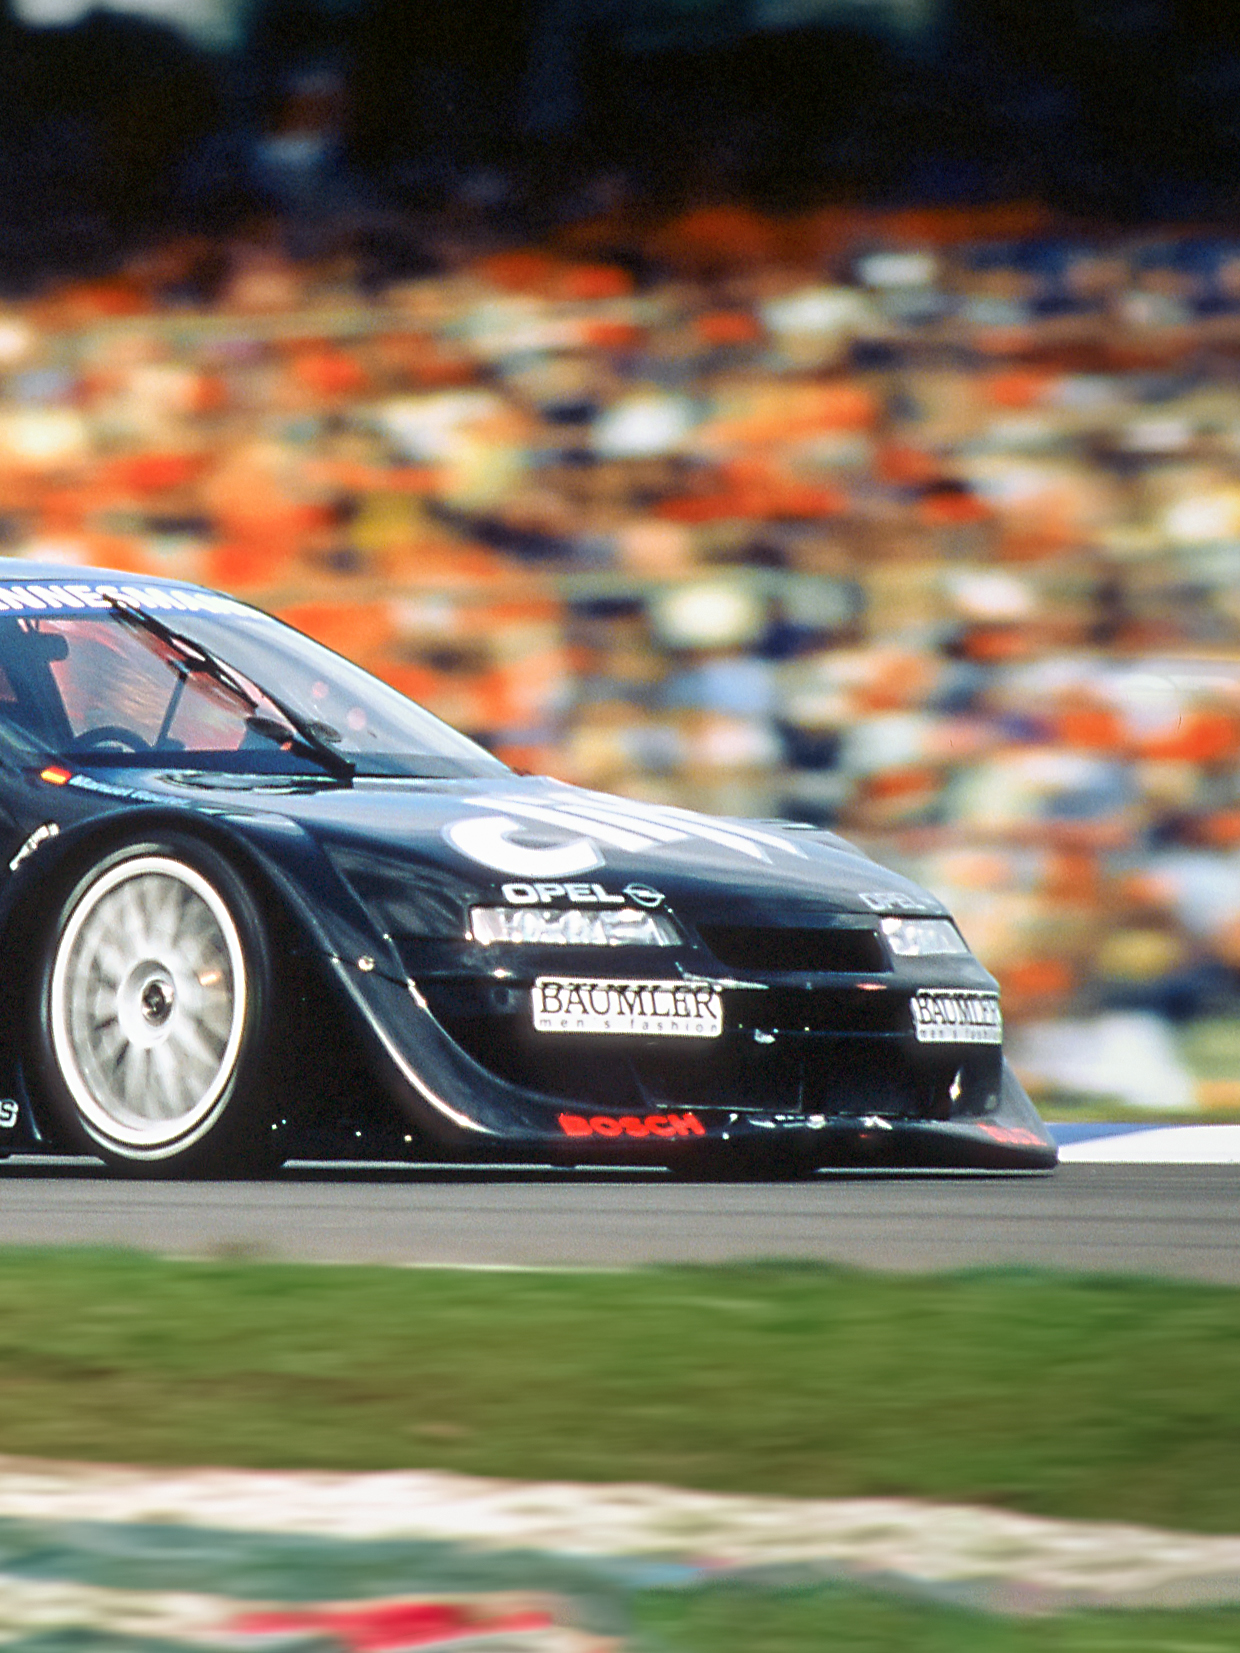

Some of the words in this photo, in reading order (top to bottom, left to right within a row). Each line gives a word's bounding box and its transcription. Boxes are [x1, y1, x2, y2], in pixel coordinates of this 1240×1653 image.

[501, 883, 625, 904] OPEL
[630, 1018, 718, 1034] fashion
[558, 1112, 706, 1138] BOSCH
